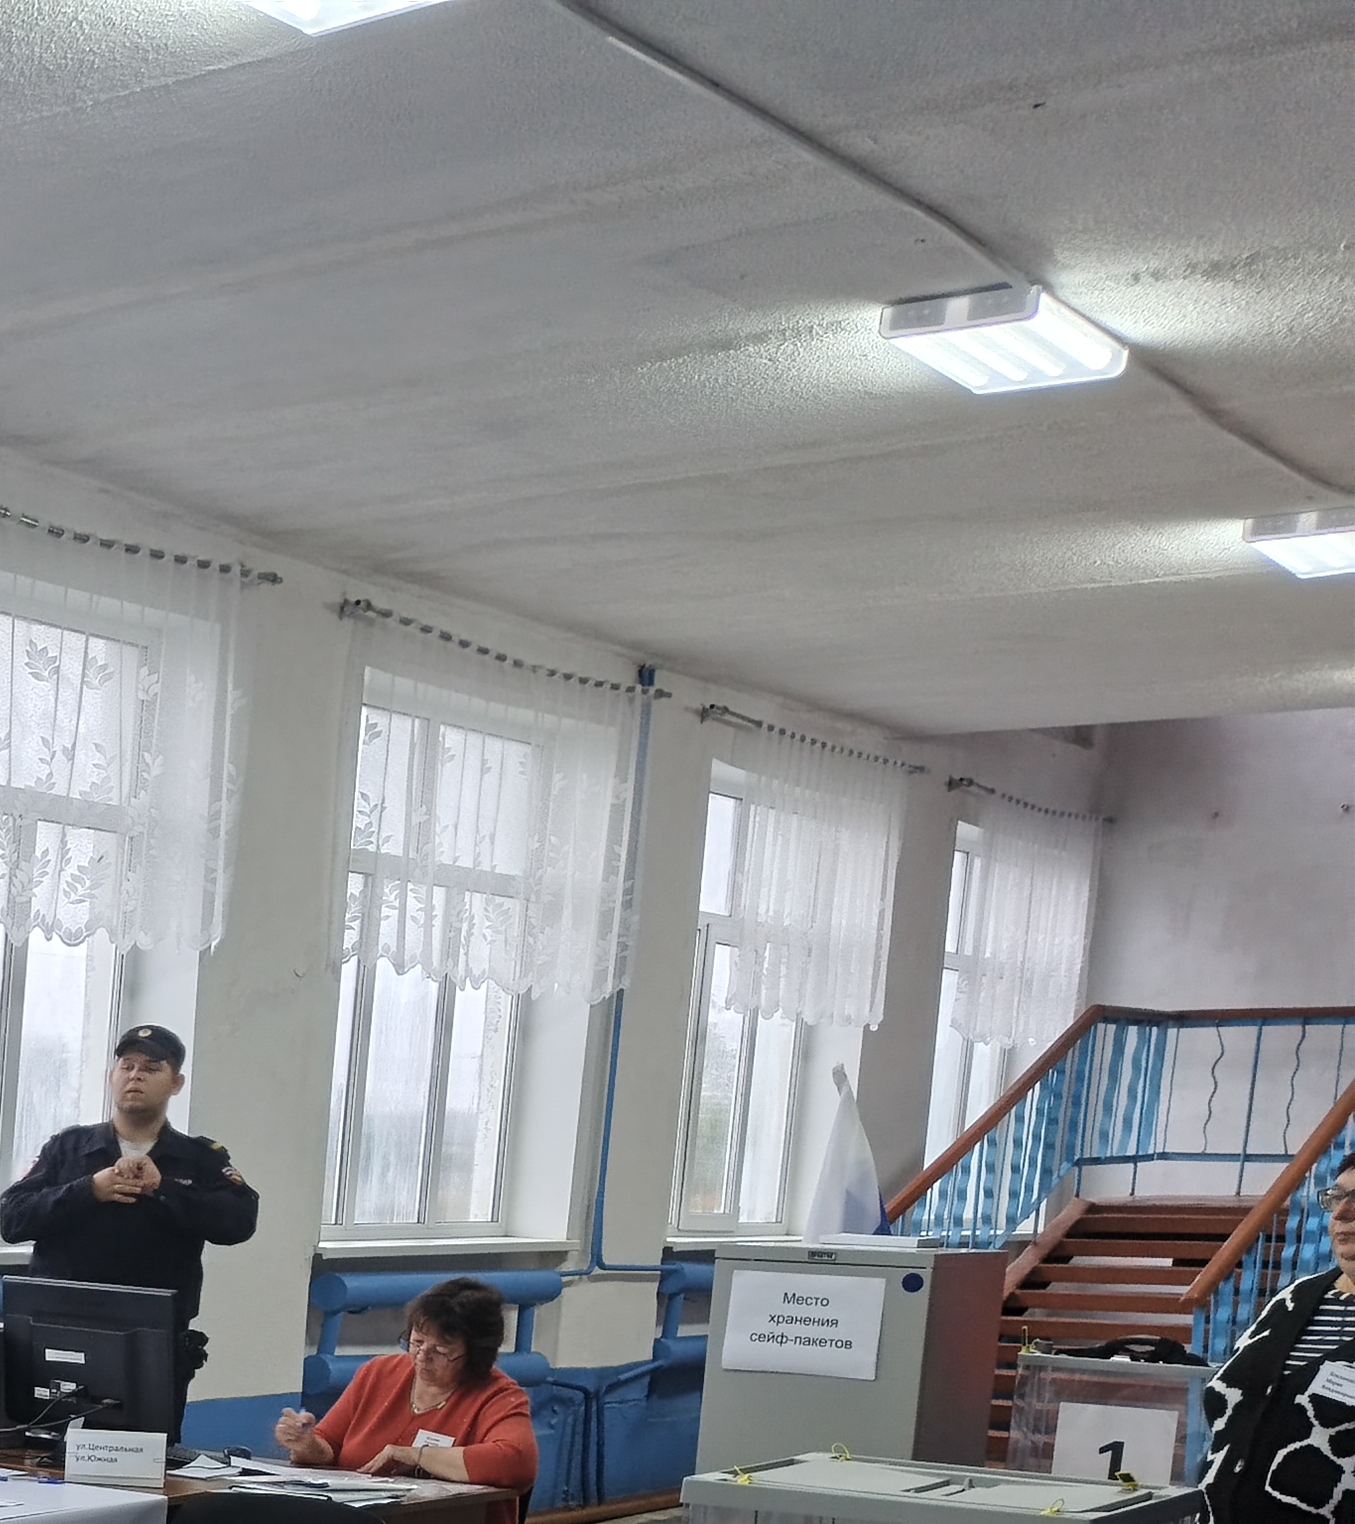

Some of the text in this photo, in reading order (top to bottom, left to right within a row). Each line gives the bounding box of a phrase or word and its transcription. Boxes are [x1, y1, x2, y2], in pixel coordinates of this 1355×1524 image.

[782, 1291, 830, 1307] Место
[768, 1313, 839, 1328] хранения
[749, 1331, 853, 1350] сейф-пакетов
[1098, 1440, 1127, 1481] 1
